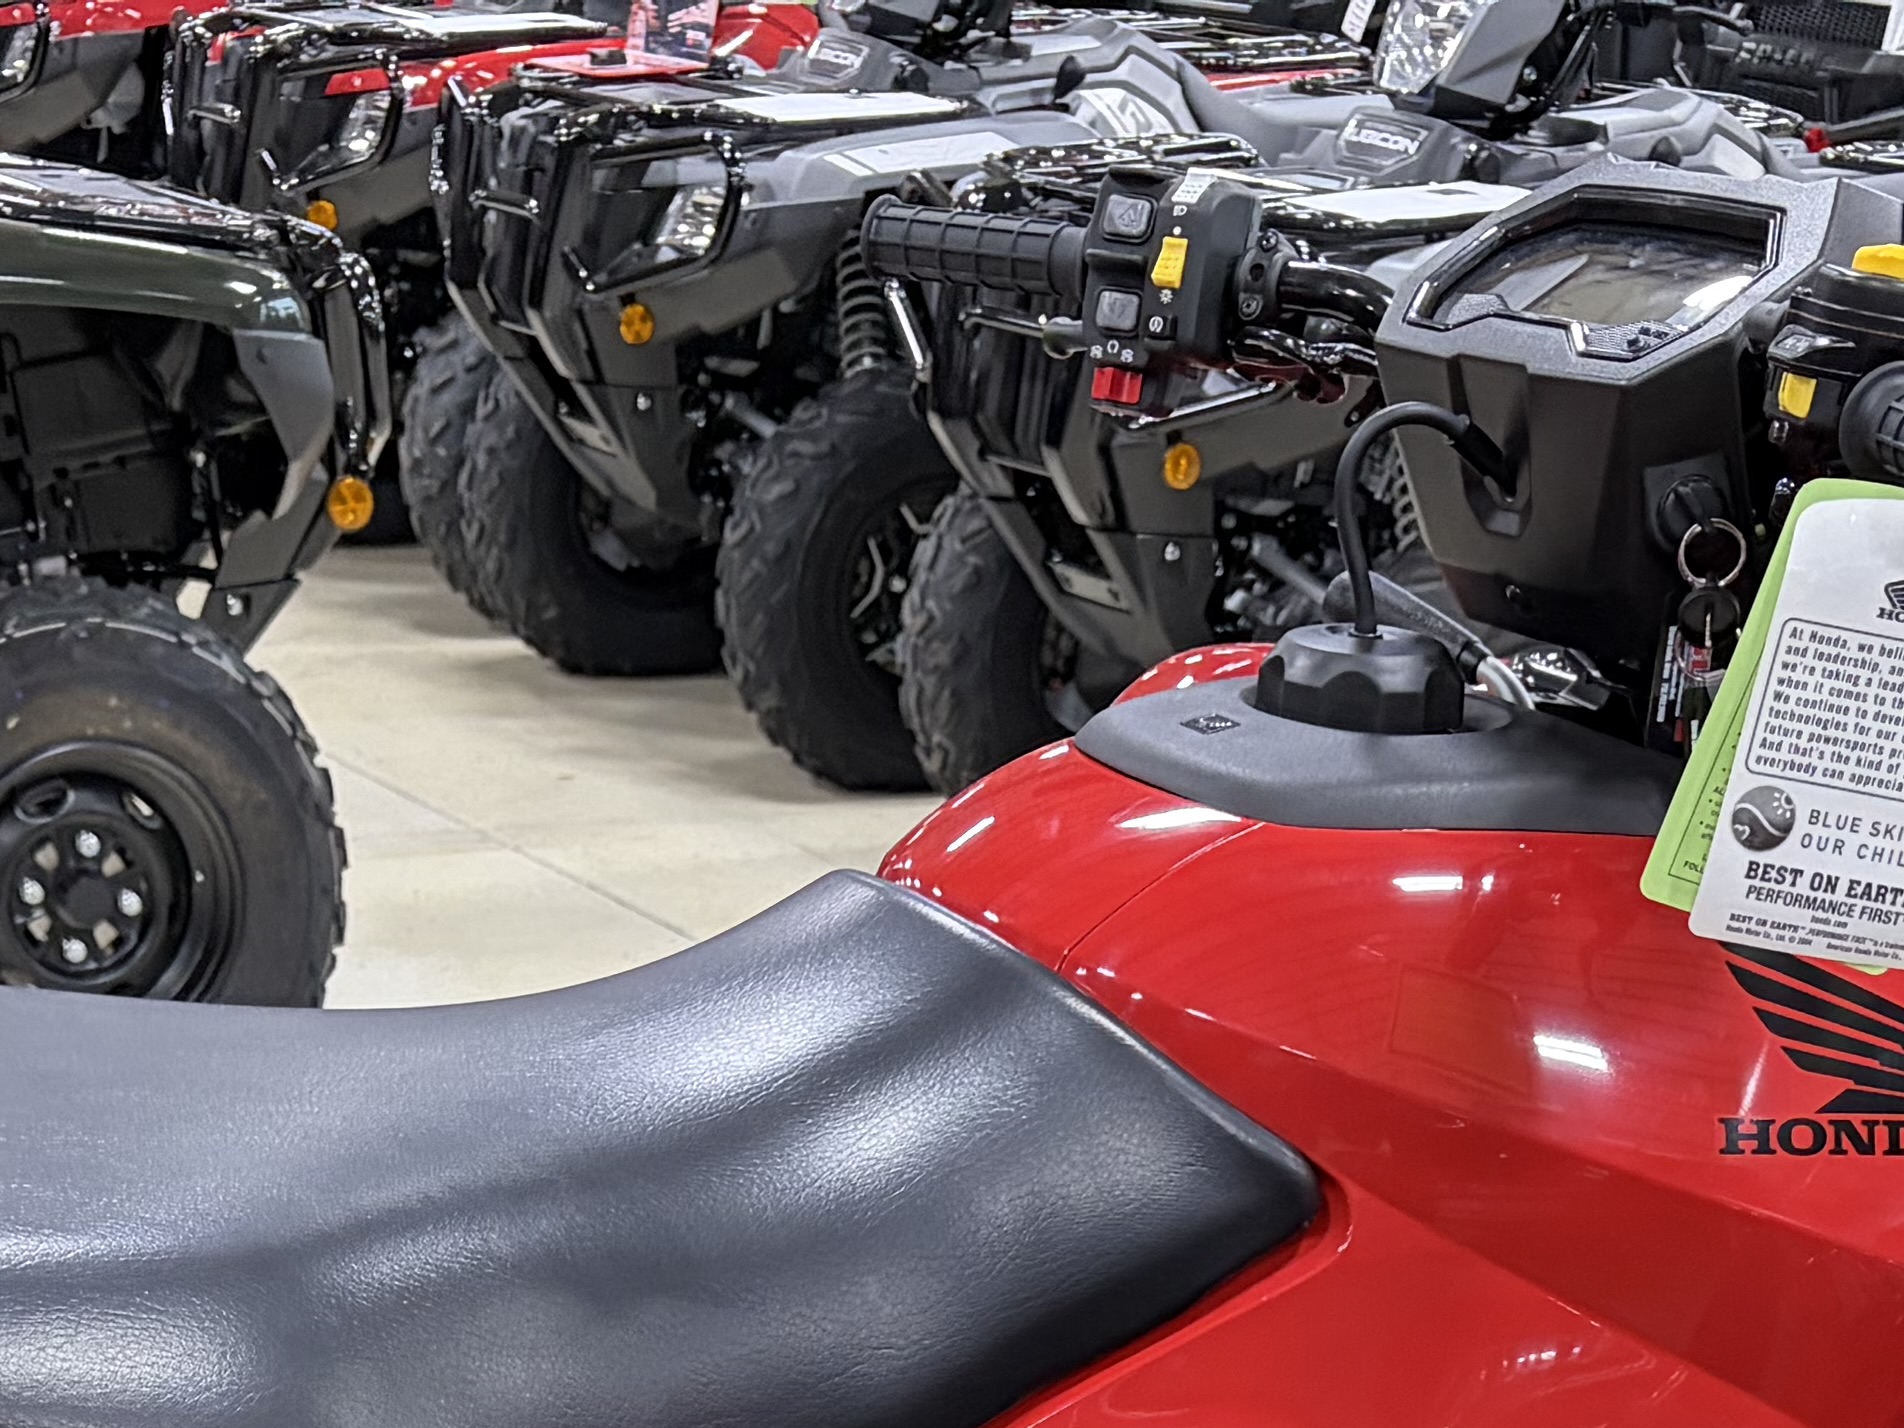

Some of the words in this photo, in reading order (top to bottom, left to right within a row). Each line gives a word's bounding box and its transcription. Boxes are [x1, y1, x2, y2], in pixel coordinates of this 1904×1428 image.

[1788, 626, 1804, 642] At
[1808, 630, 1851, 652] Honda,
[1857, 642, 1875, 655] we
[1781, 660, 1817, 677] we're
[1820, 666, 1862, 688] taking
[1864, 677, 1873, 688] a
[1784, 645, 1809, 659] and
[1812, 649, 1882, 675] leadership,
[1773, 689, 1791, 705] We
[1794, 696, 1851, 717] continue
[1854, 706, 1869, 720] to
[1776, 676, 1809, 692] when
[1812, 681, 1825, 695] it
[1828, 686, 1869, 704] comes
[1873, 693, 1887, 707] to
[1763, 721, 1804, 740] future
[1806, 732, 1885, 756] powersports
[1768, 705, 1849, 733] technologies
[1852, 721, 1872, 737] for
[1875, 728, 1898, 742] our
[1755, 755, 1818, 778] everybody
[1821, 767, 1845, 781] can
[1758, 736, 1784, 753] And
[1787, 742, 1826, 761] that's
[1830, 750, 1851, 766] the
[1854, 755, 1884, 772] kind
[1886, 762, 1902, 776] of
[1808, 808, 1863, 834] BLUE
[1800, 832, 1846, 856] OUR
[1744, 860, 1805, 888] BEST
[1809, 872, 1840, 895] ON
[1745, 884, 1857, 919] PERFORMANCE
